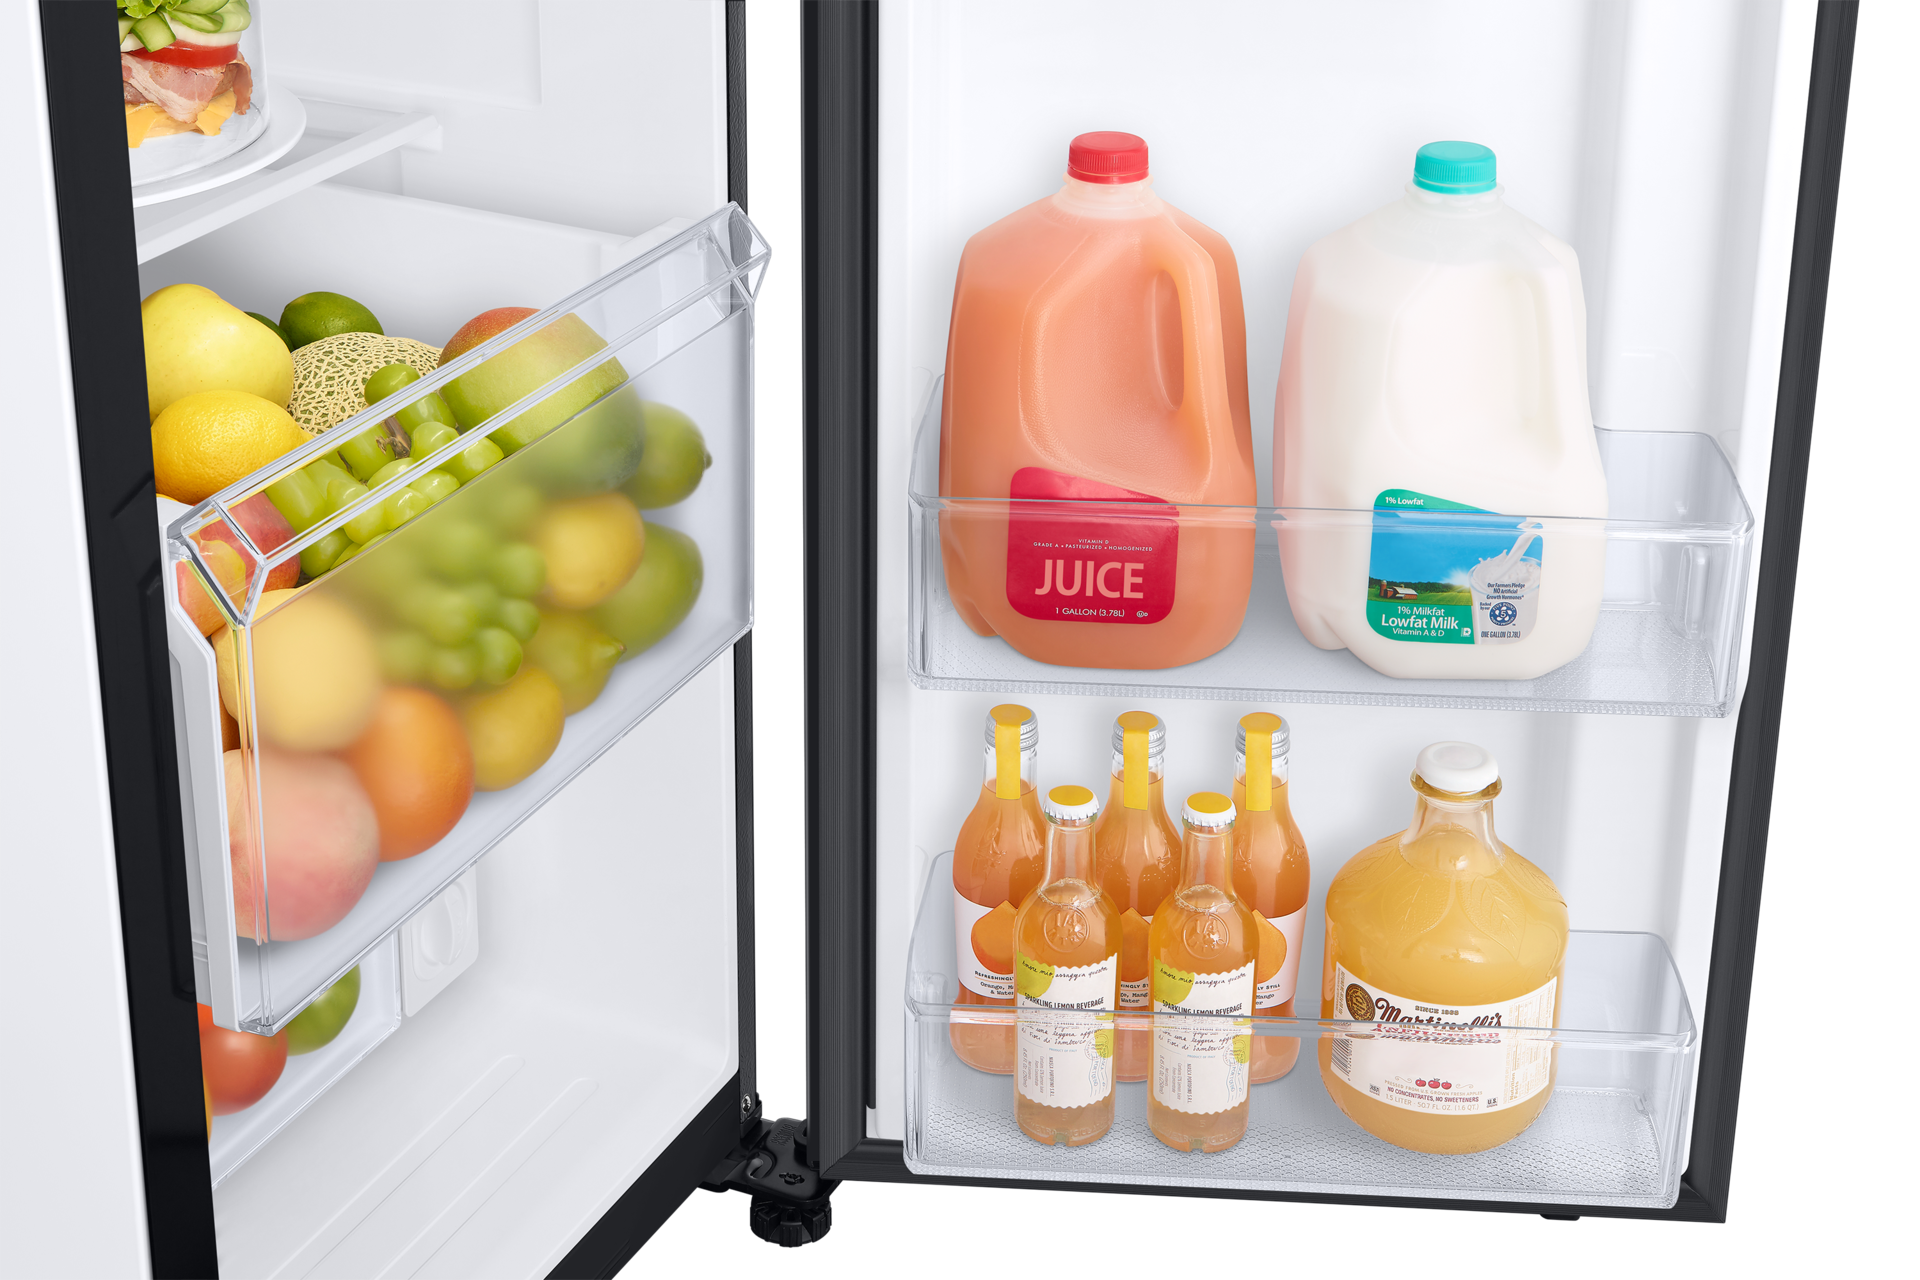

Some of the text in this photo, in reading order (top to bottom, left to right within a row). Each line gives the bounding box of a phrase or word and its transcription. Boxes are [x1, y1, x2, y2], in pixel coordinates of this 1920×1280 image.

[1385, 496, 1424, 506] 1% Lowfat
[1034, 559, 1144, 599] JUICE
[1062, 608, 1097, 616] GALLON
[1099, 608, 1125, 617] (3.78L)
[1397, 606, 1445, 616] 1% Milkfat
[1382, 614, 1459, 630] Lowfat Milk
[975, 970, 1013, 980] REFRESHINGL
[980, 982, 1004, 990] Orange,
[1024, 992, 1104, 1010] SPARKLING LEMON BEVERAGE
[1162, 1000, 1191, 1014] SPARKLING
[1216, 1003, 1243, 1014] BEVERAGE
[1375, 997, 1502, 1027] Martilli's
[1415, 1005, 1439, 1014] SINCE
[1385, 1080, 1404, 1089] PRESSED
[1395, 1089, 1434, 1102] CONCENTRATES,
[1395, 1096, 1412, 1106] LITER
